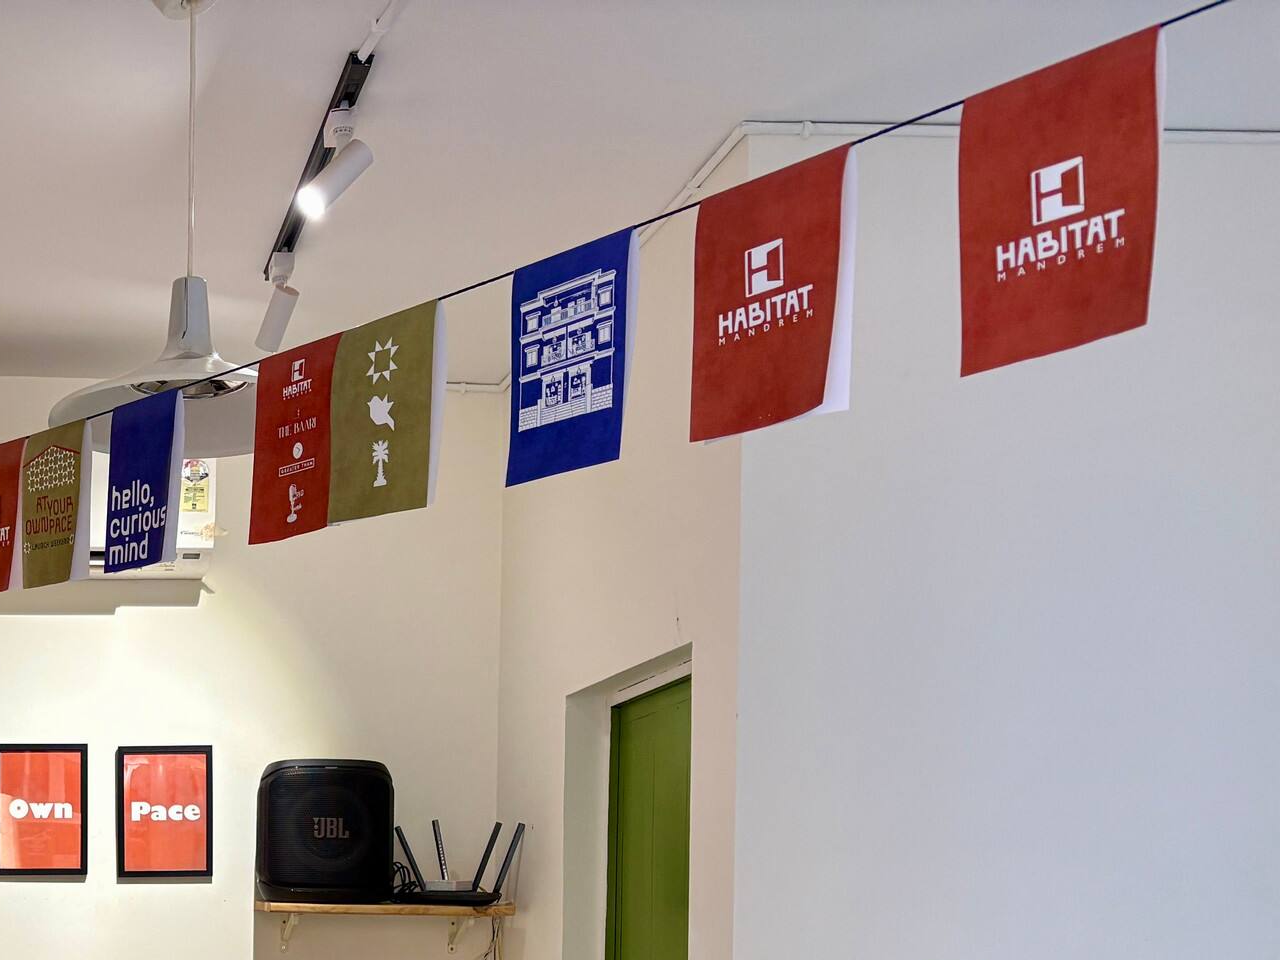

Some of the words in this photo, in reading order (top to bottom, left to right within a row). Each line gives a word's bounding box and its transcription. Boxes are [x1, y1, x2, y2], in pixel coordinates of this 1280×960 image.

[995, 208, 1126, 272] HABITAT
[996, 237, 1126, 282] MANDREM
[718, 284, 814, 337] HABITAT
[718, 309, 814, 347] MANDREM
[282, 379, 313, 397] HABITAT
[111, 479, 155, 511] hello,
[110, 505, 167, 539] curious
[108, 532, 149, 566] mind
[8, 798, 74, 820] Own
[130, 801, 201, 822] Pace
[312, 817, 350, 839] JBL
